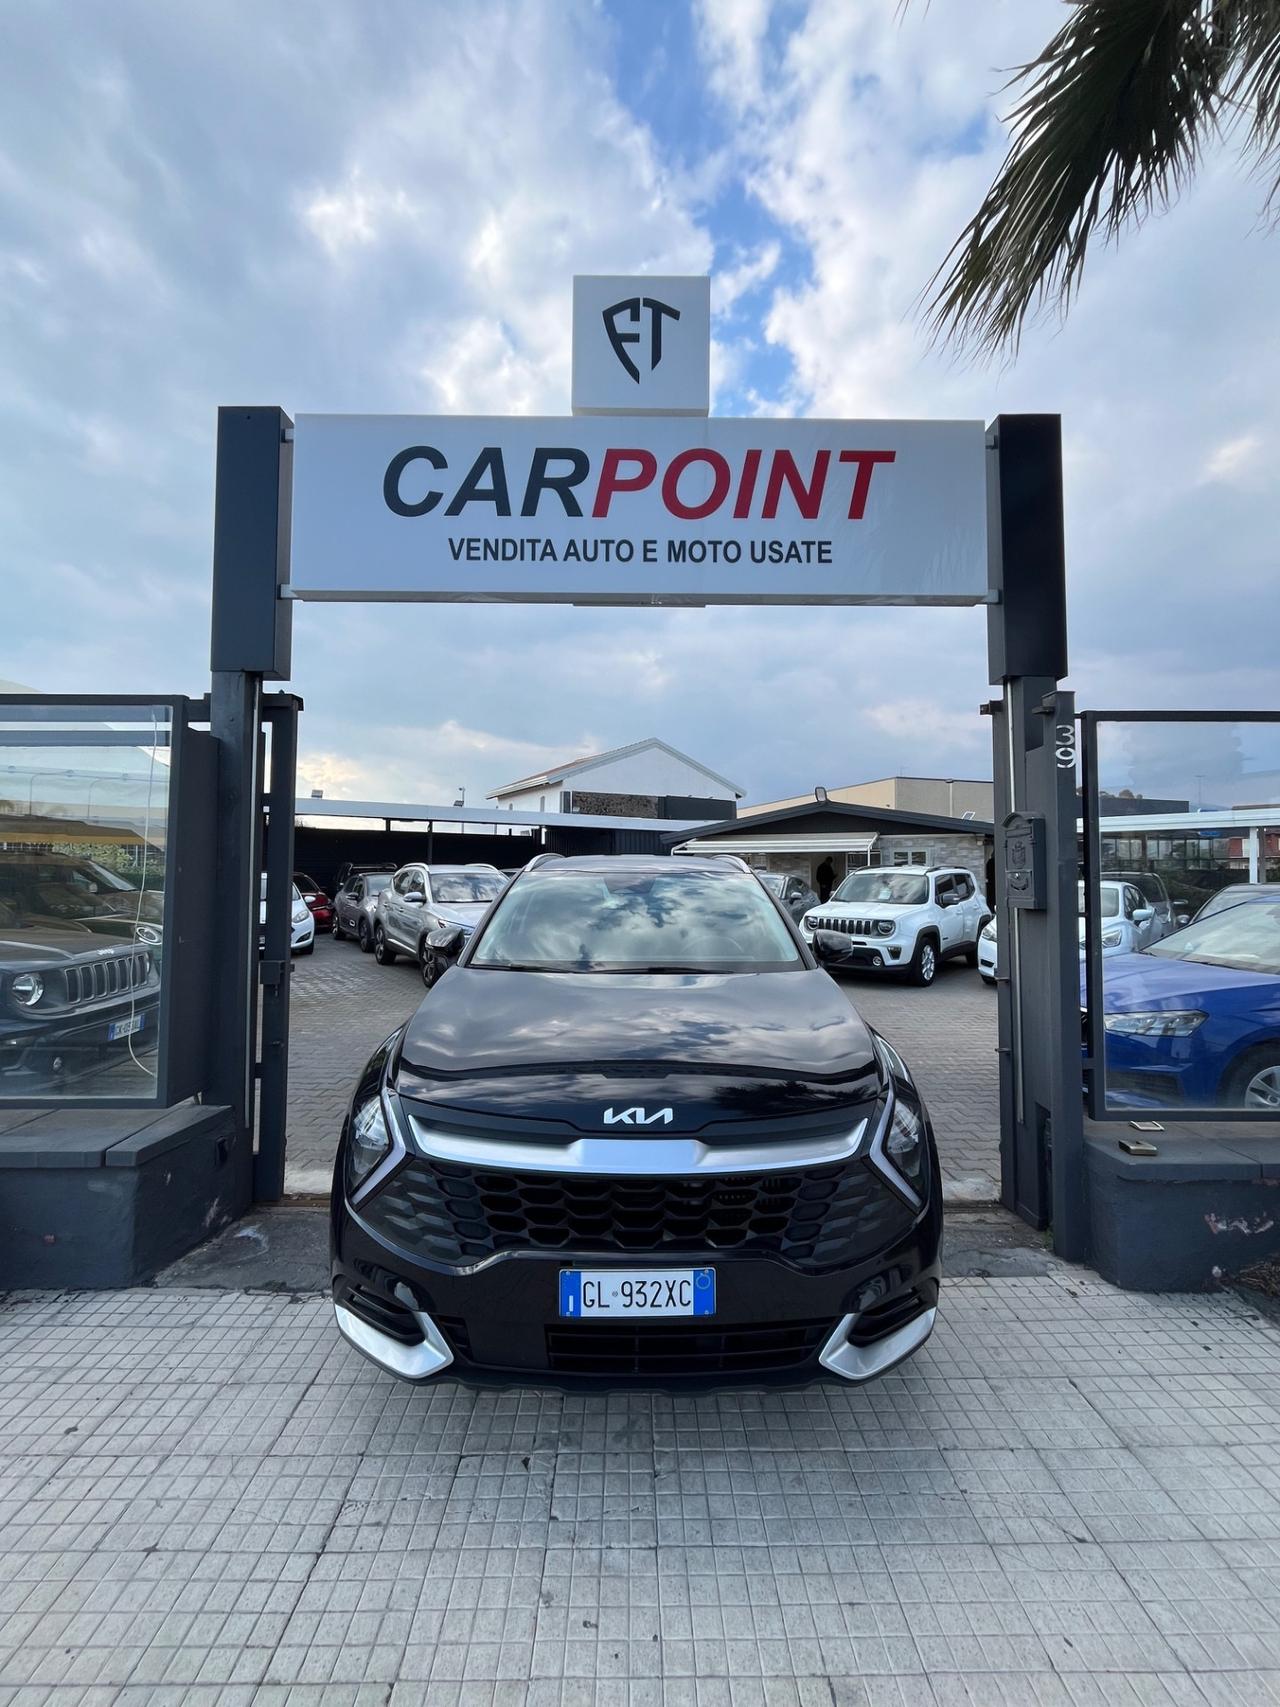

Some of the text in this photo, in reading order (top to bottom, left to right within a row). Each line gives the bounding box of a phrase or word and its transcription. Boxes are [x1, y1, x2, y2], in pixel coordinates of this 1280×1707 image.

[383, 445, 897, 520] CARPOINT
[448, 537, 833, 564] VENDITA AUTO E MOTO USATE
[1055, 724, 1076, 769] 39
[603, 1107, 674, 1125] KIA
